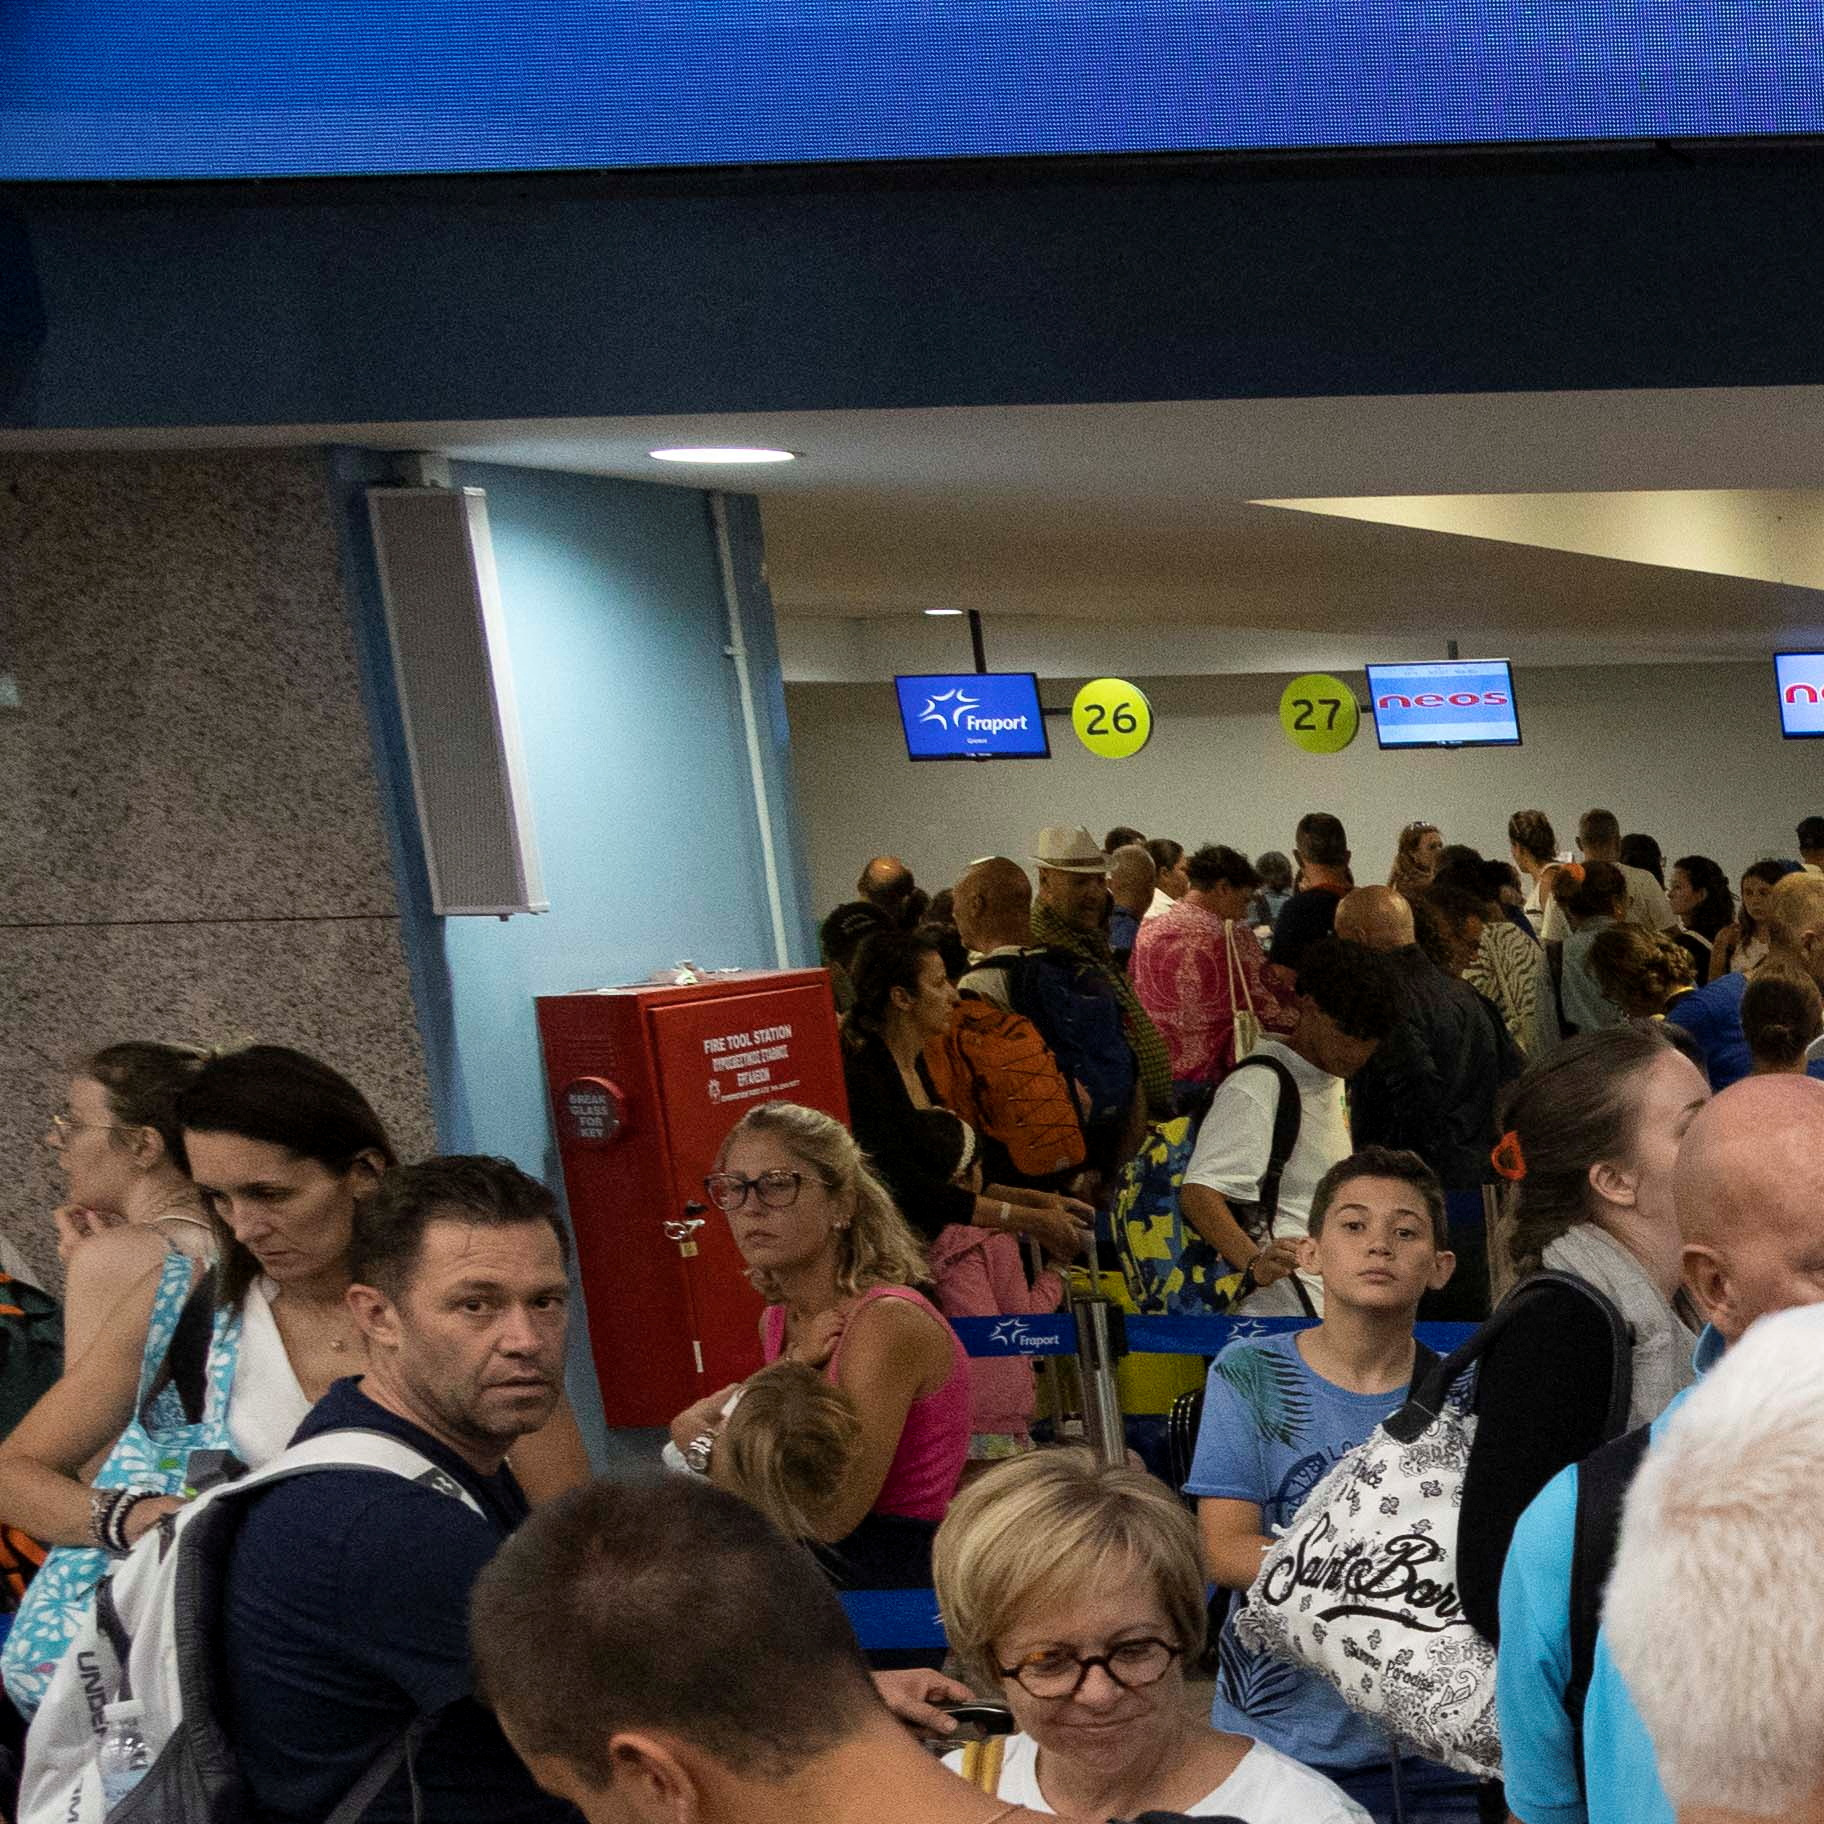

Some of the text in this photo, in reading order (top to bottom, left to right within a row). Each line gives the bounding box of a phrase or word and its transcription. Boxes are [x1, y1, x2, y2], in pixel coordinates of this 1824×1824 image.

[1377, 690, 1509, 710] neos
[967, 714, 1028, 734] Fraport
[1084, 702, 1137, 736] 26
[1292, 698, 1342, 732] 27
[703, 1024, 792, 1055] FIRE TOOL STATION
[568, 1094, 607, 1104] BREAK
[569, 1104, 609, 1116] GLASS
[580, 1116, 603, 1126] FOR
[580, 1128, 604, 1137] KEY
[1019, 1334, 1060, 1349] Fraport
[1345, 1533, 1462, 1618] Bar
[1386, 1659, 1434, 1691] Paradise
